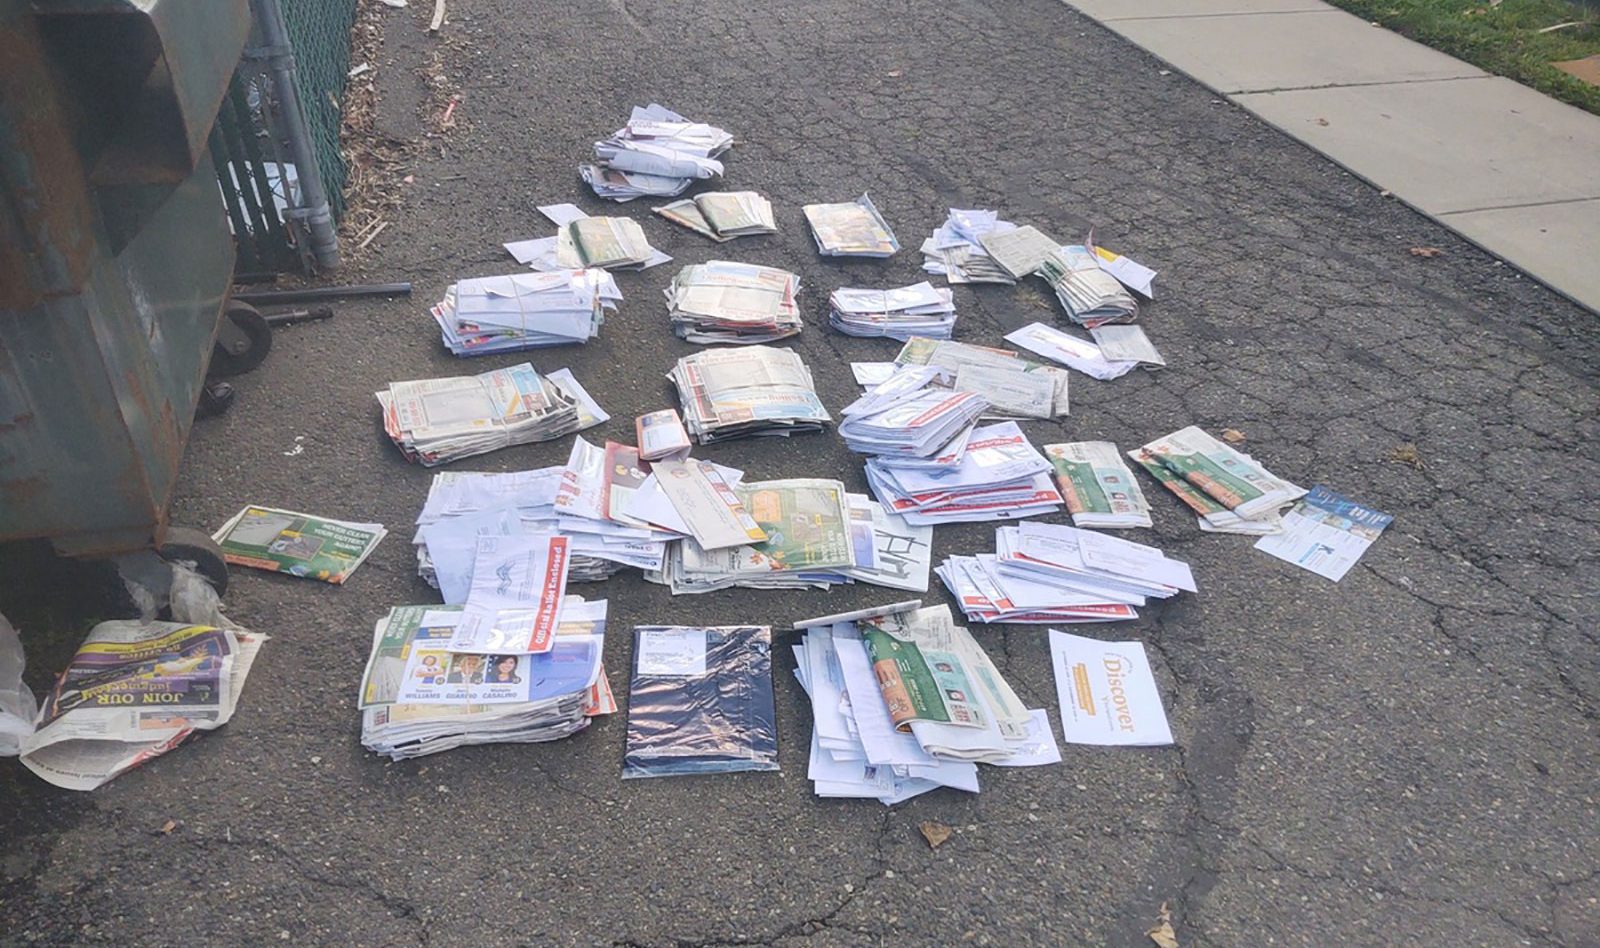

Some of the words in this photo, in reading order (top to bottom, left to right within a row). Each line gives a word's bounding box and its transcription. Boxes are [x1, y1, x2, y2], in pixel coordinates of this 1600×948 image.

[535, 615, 550, 644] Official
[548, 546, 562, 589] Enclosed
[96, 692, 135, 705] OUR
[142, 692, 184, 704] JOIN
[1103, 657, 1136, 733] Discover
